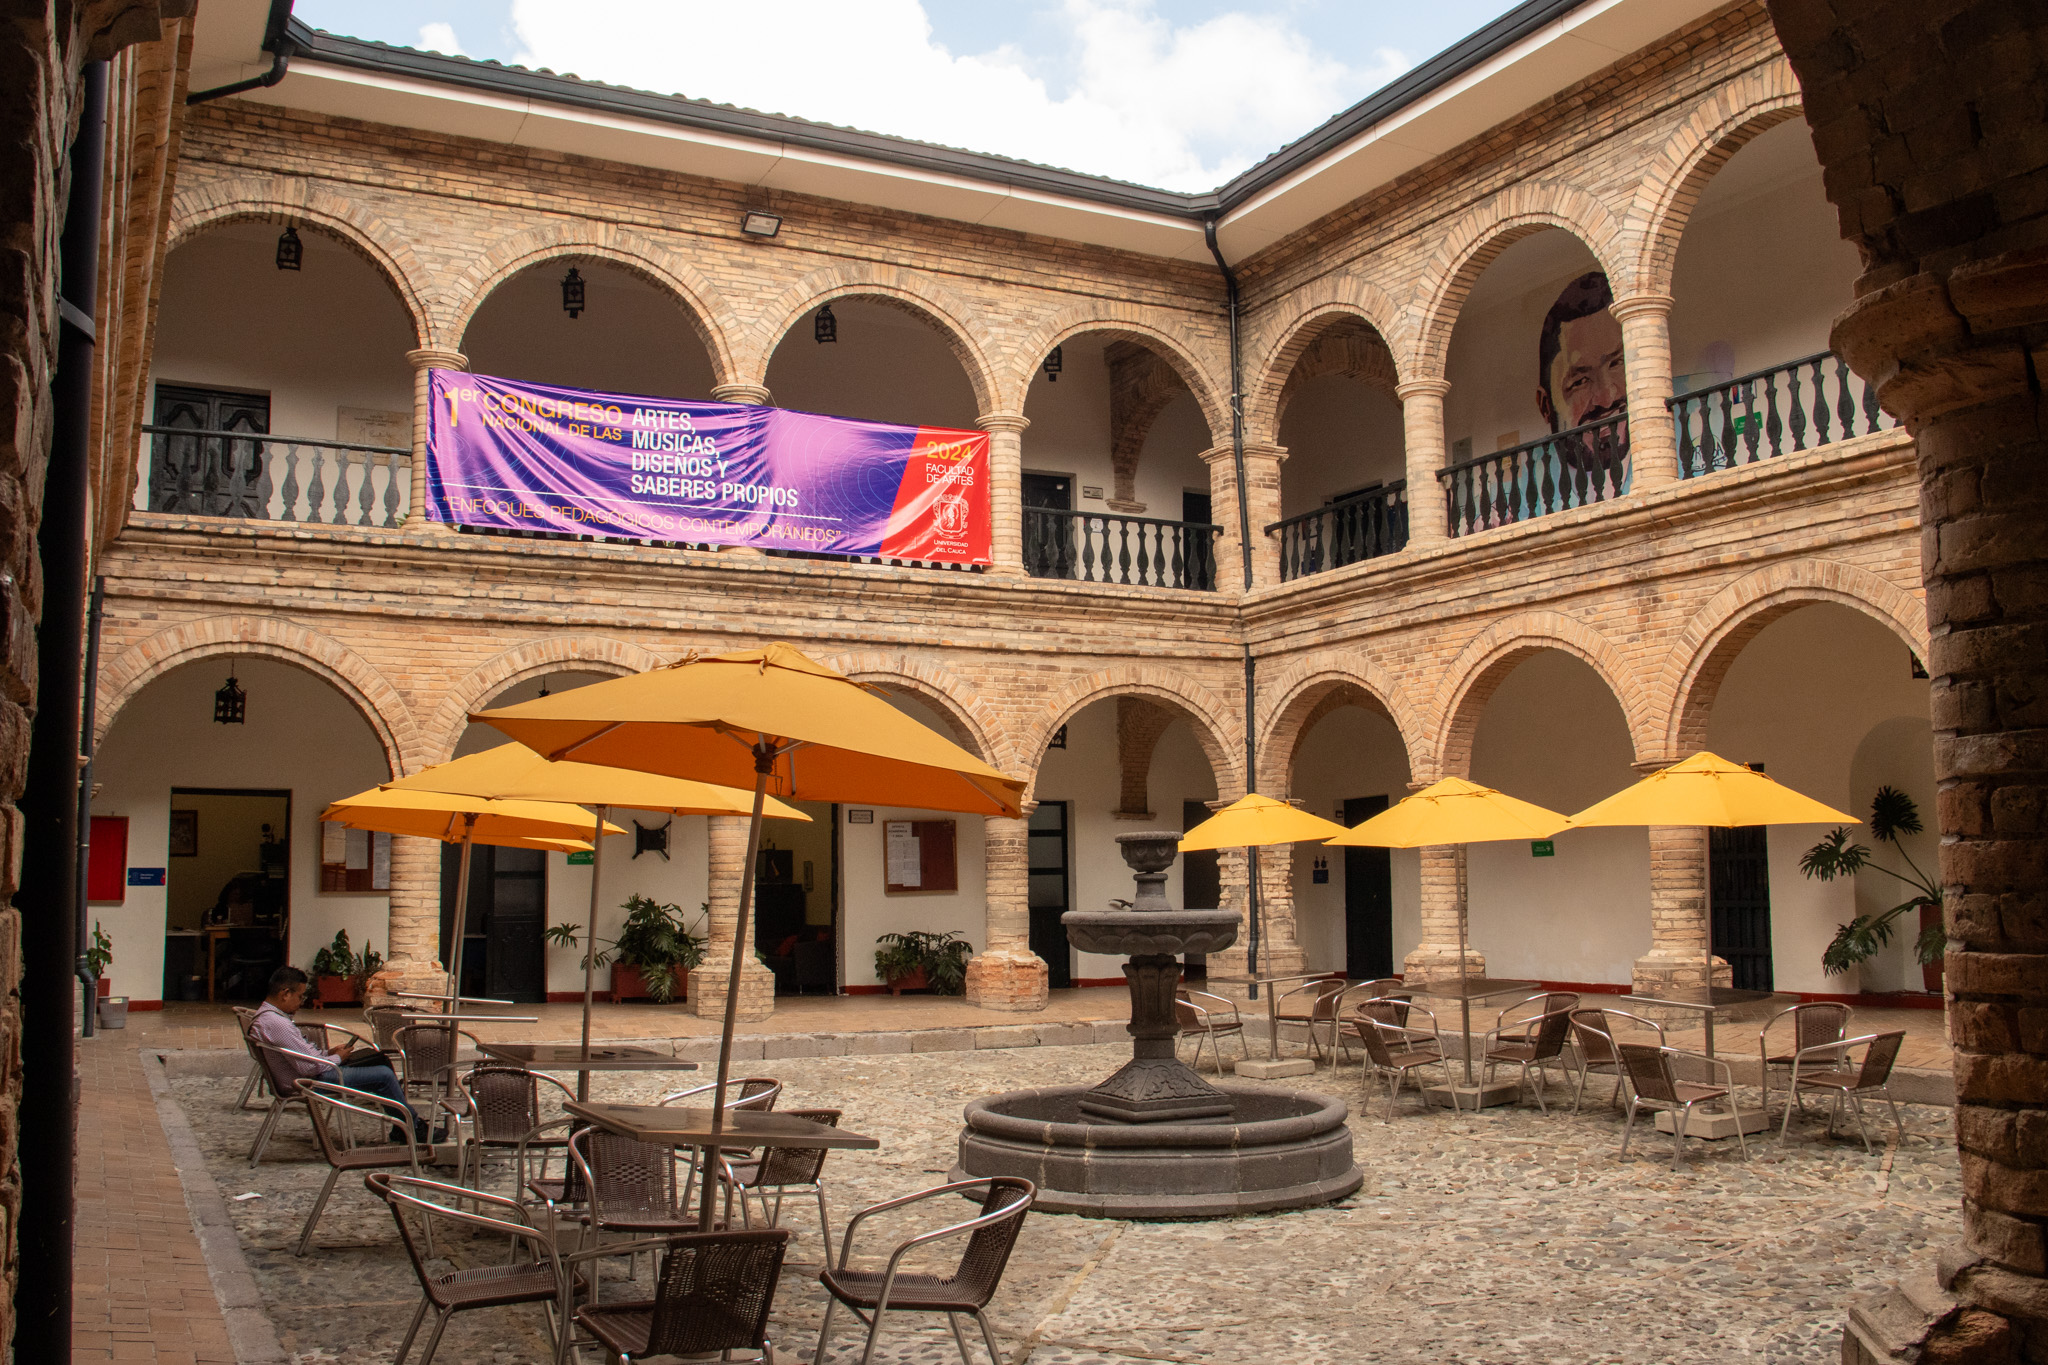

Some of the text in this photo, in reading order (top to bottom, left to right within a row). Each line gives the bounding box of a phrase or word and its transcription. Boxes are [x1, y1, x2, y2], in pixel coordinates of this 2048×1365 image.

[483, 392, 623, 425] CONGRESO
[632, 408, 696, 435] ARTES,
[482, 412, 622, 441] NACIONAL DE LAS
[632, 427, 720, 459] MÚSICAS,
[926, 441, 973, 461] 2024
[632, 452, 729, 478] DISEÑOS Y
[926, 463, 974, 476] FACULTAD
[631, 474, 798, 507] SABERES PROPIOS
[926, 473, 974, 486] DE ARTES
[550, 505, 674, 530] PEDAGÓGICOS
[933, 539, 969, 548] UNIVERSIDAD
